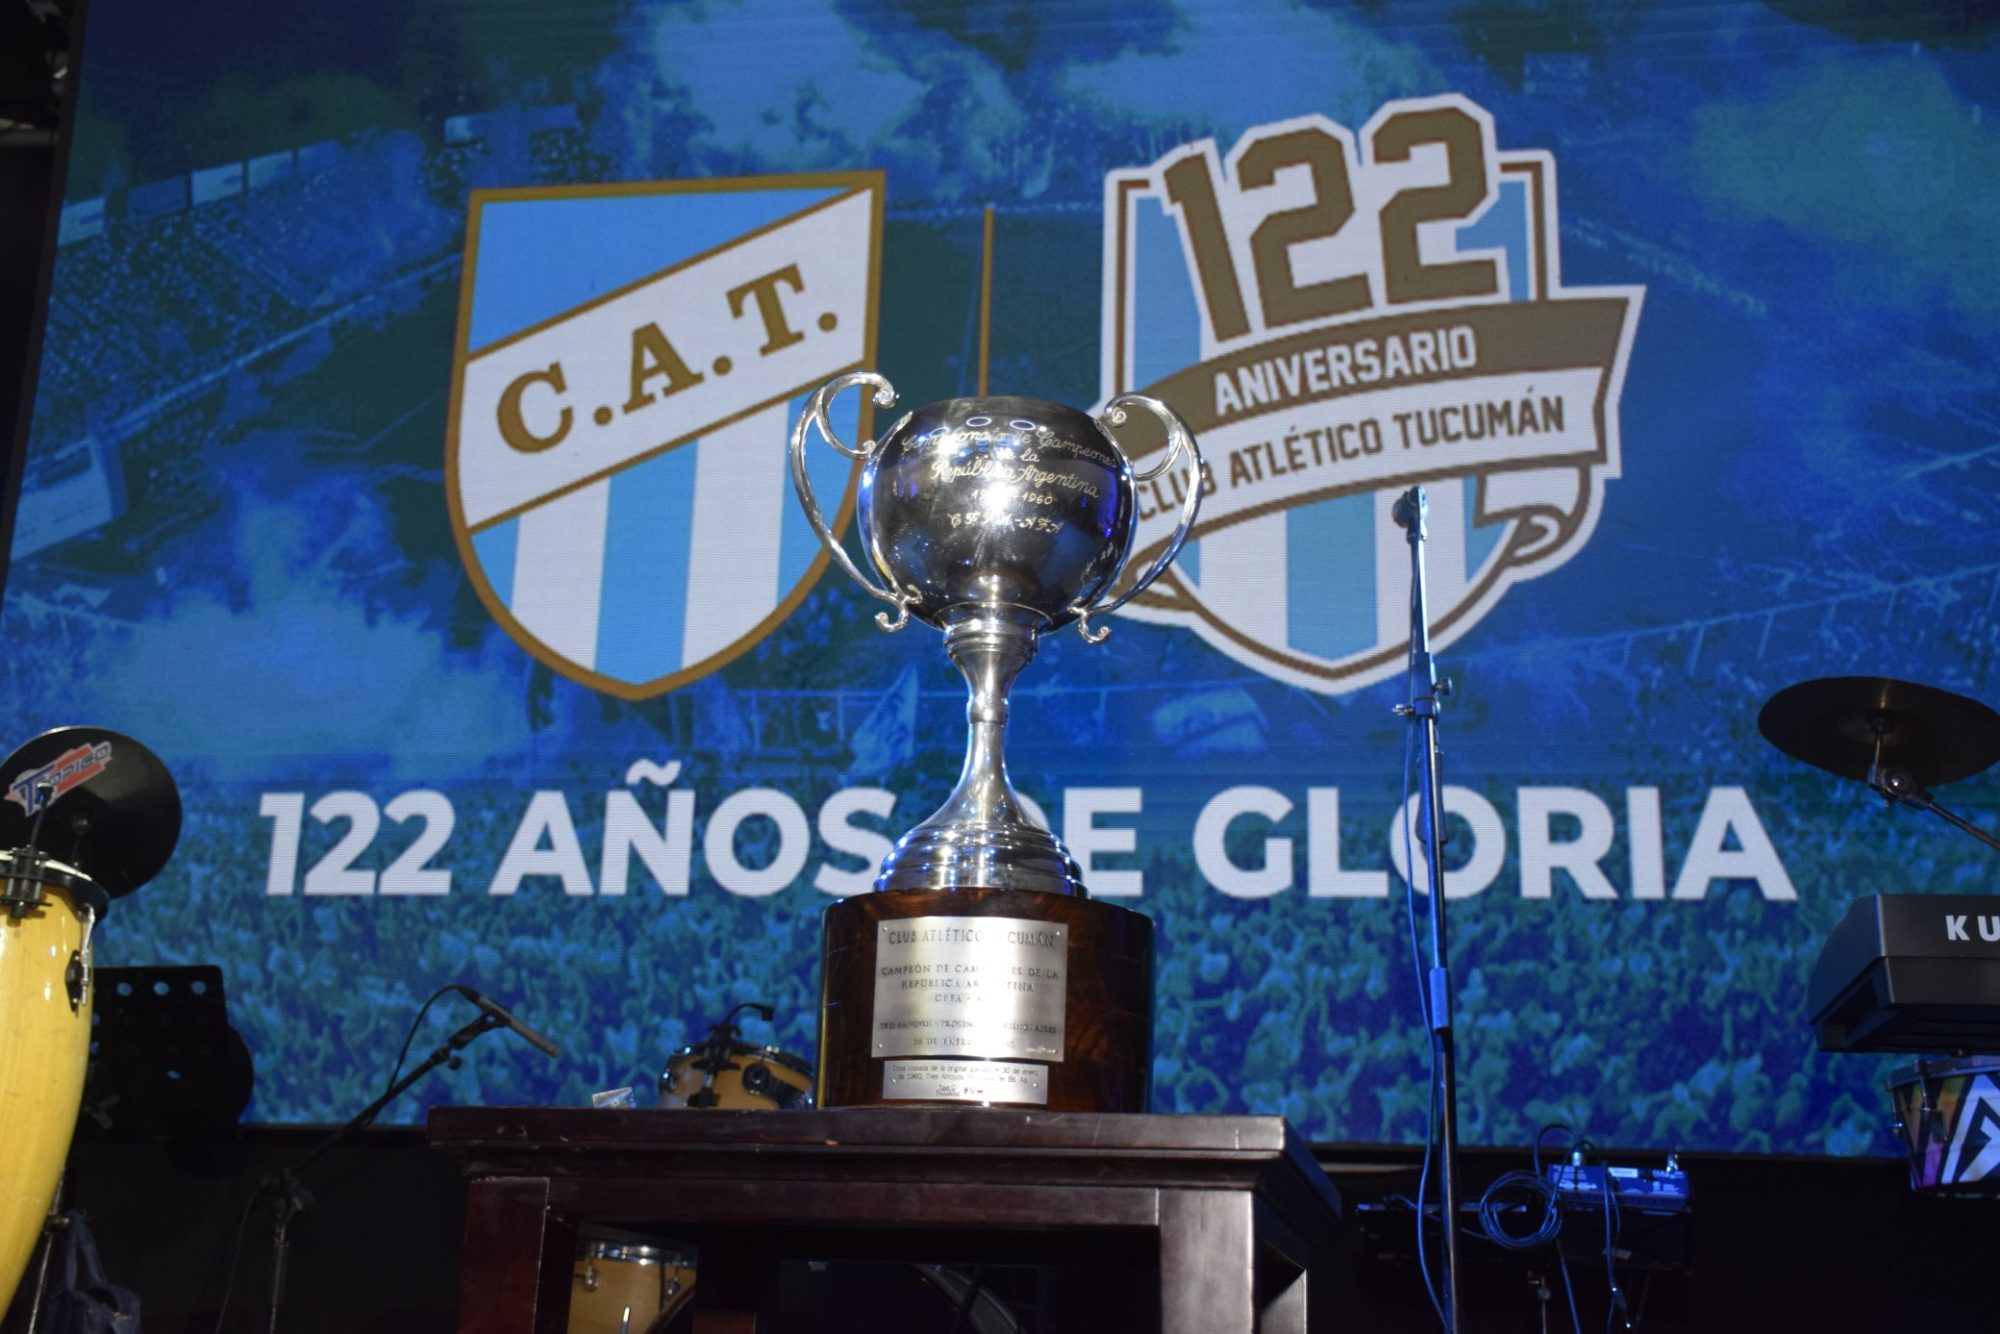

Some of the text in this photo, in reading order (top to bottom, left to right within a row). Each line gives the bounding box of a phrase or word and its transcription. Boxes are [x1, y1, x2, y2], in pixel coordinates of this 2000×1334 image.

[1164, 106, 1499, 343] 122
[496, 262, 838, 454] C.A.T.
[1213, 325, 1478, 418] ANIVERSARIO
[1035, 429, 1118, 469] Campeones
[1229, 420, 1383, 488] ATLÉTICO
[1393, 386, 1565, 450] TUCUMÁN
[1012, 464, 1099, 498] Argentina
[1021, 491, 1054, 505] 1960
[258, 790, 456, 896] 122
[488, 758, 897, 897] AÑOS
[1192, 785, 1798, 901] GLORIA
[888, 930, 917, 945] CLUB
[922, 927, 984, 943] ATLÉTICO
[936, 964, 949, 973] DE
[1028, 967, 1041, 977] DE
[1046, 968, 1060, 979] LA
